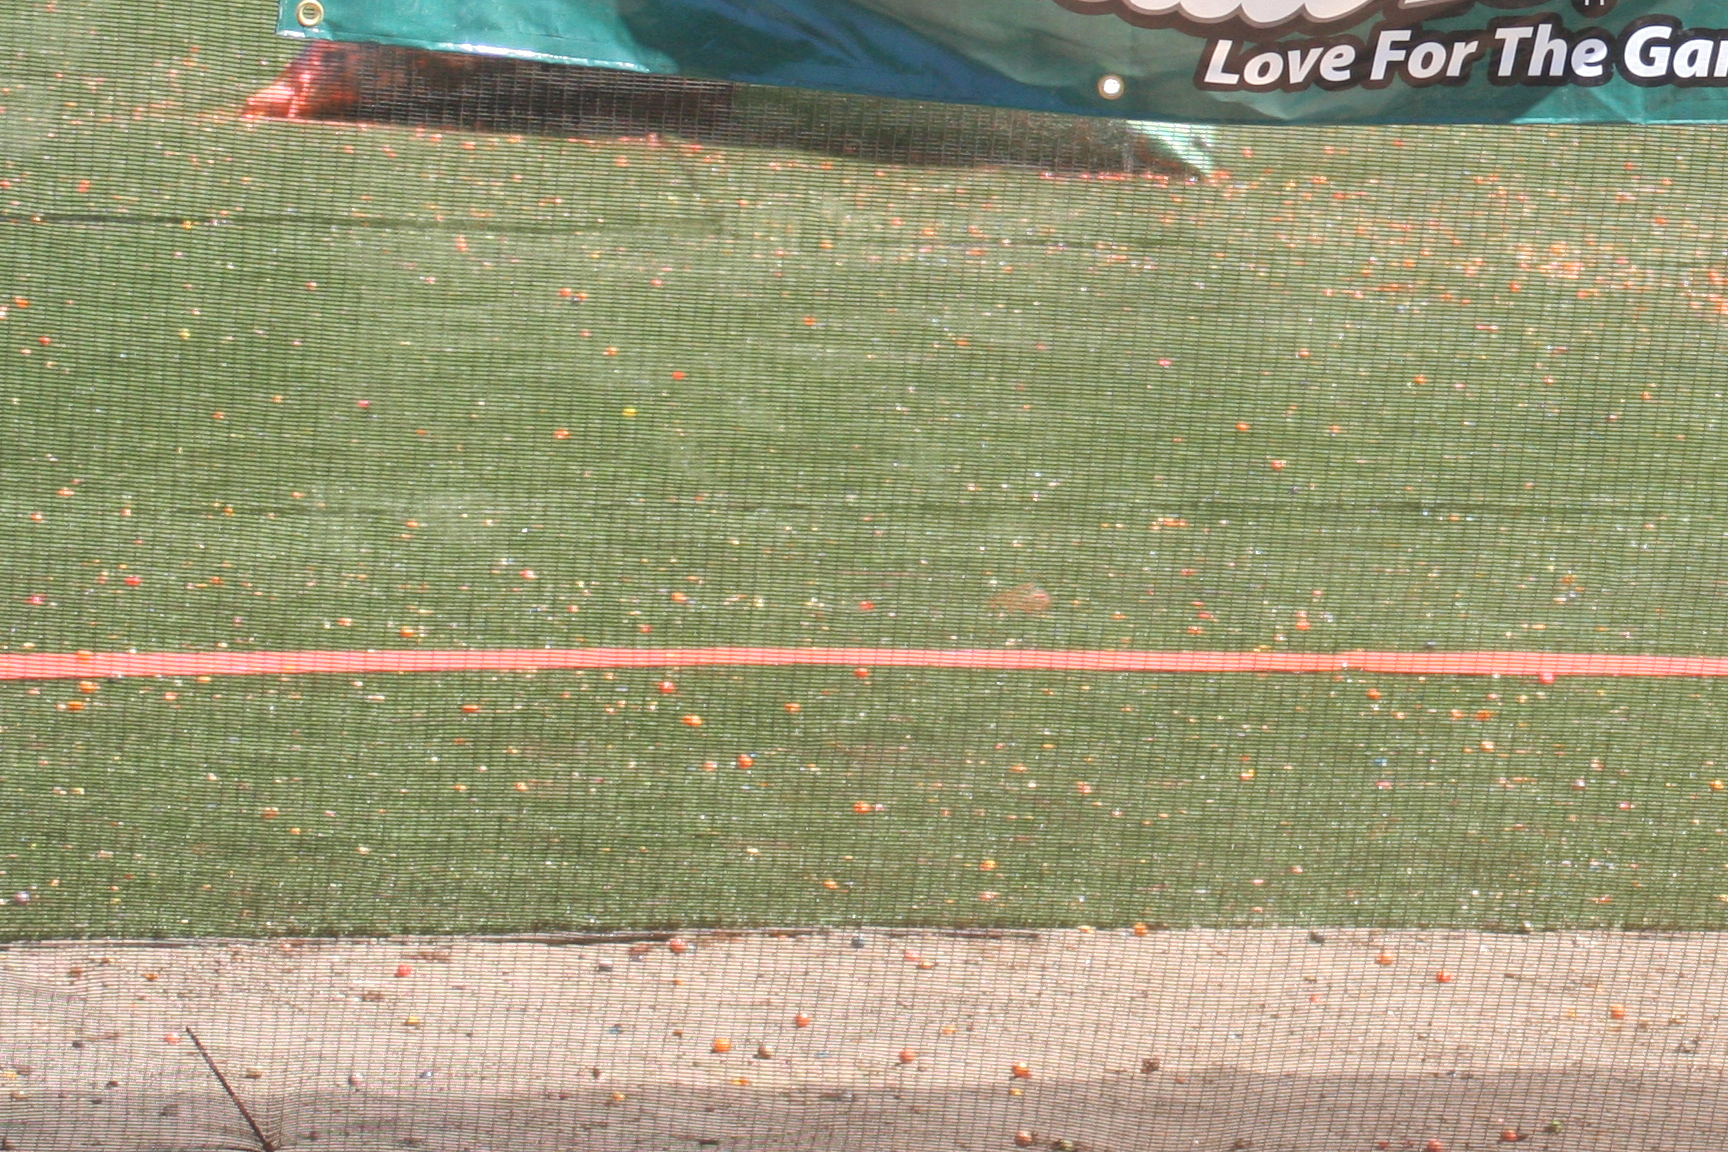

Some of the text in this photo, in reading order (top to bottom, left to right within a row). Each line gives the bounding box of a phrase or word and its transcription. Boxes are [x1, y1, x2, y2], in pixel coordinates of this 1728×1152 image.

[1204, 39, 1350, 86] Love
[1370, 29, 1478, 81] For
[1495, 24, 1605, 78] The
